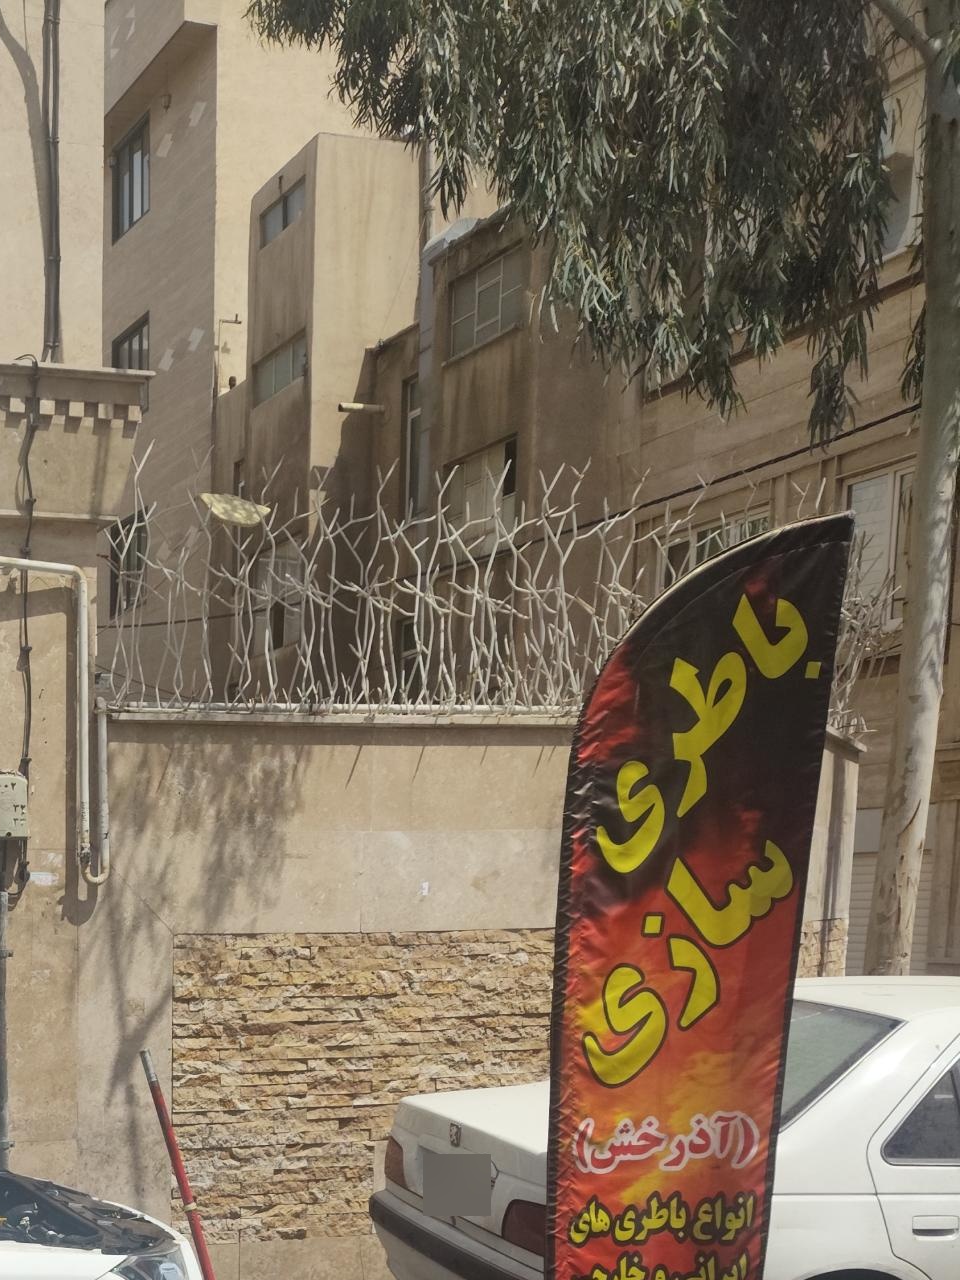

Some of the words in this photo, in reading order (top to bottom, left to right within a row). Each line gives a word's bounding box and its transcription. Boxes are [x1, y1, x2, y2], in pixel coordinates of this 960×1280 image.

[596, 592, 822, 874] باطری
[583, 839, 796, 1088] سازی
[569, 1200, 611, 1244] های
[613, 1196, 687, 1242] باطری
[692, 1196, 756, 1241] انواع
